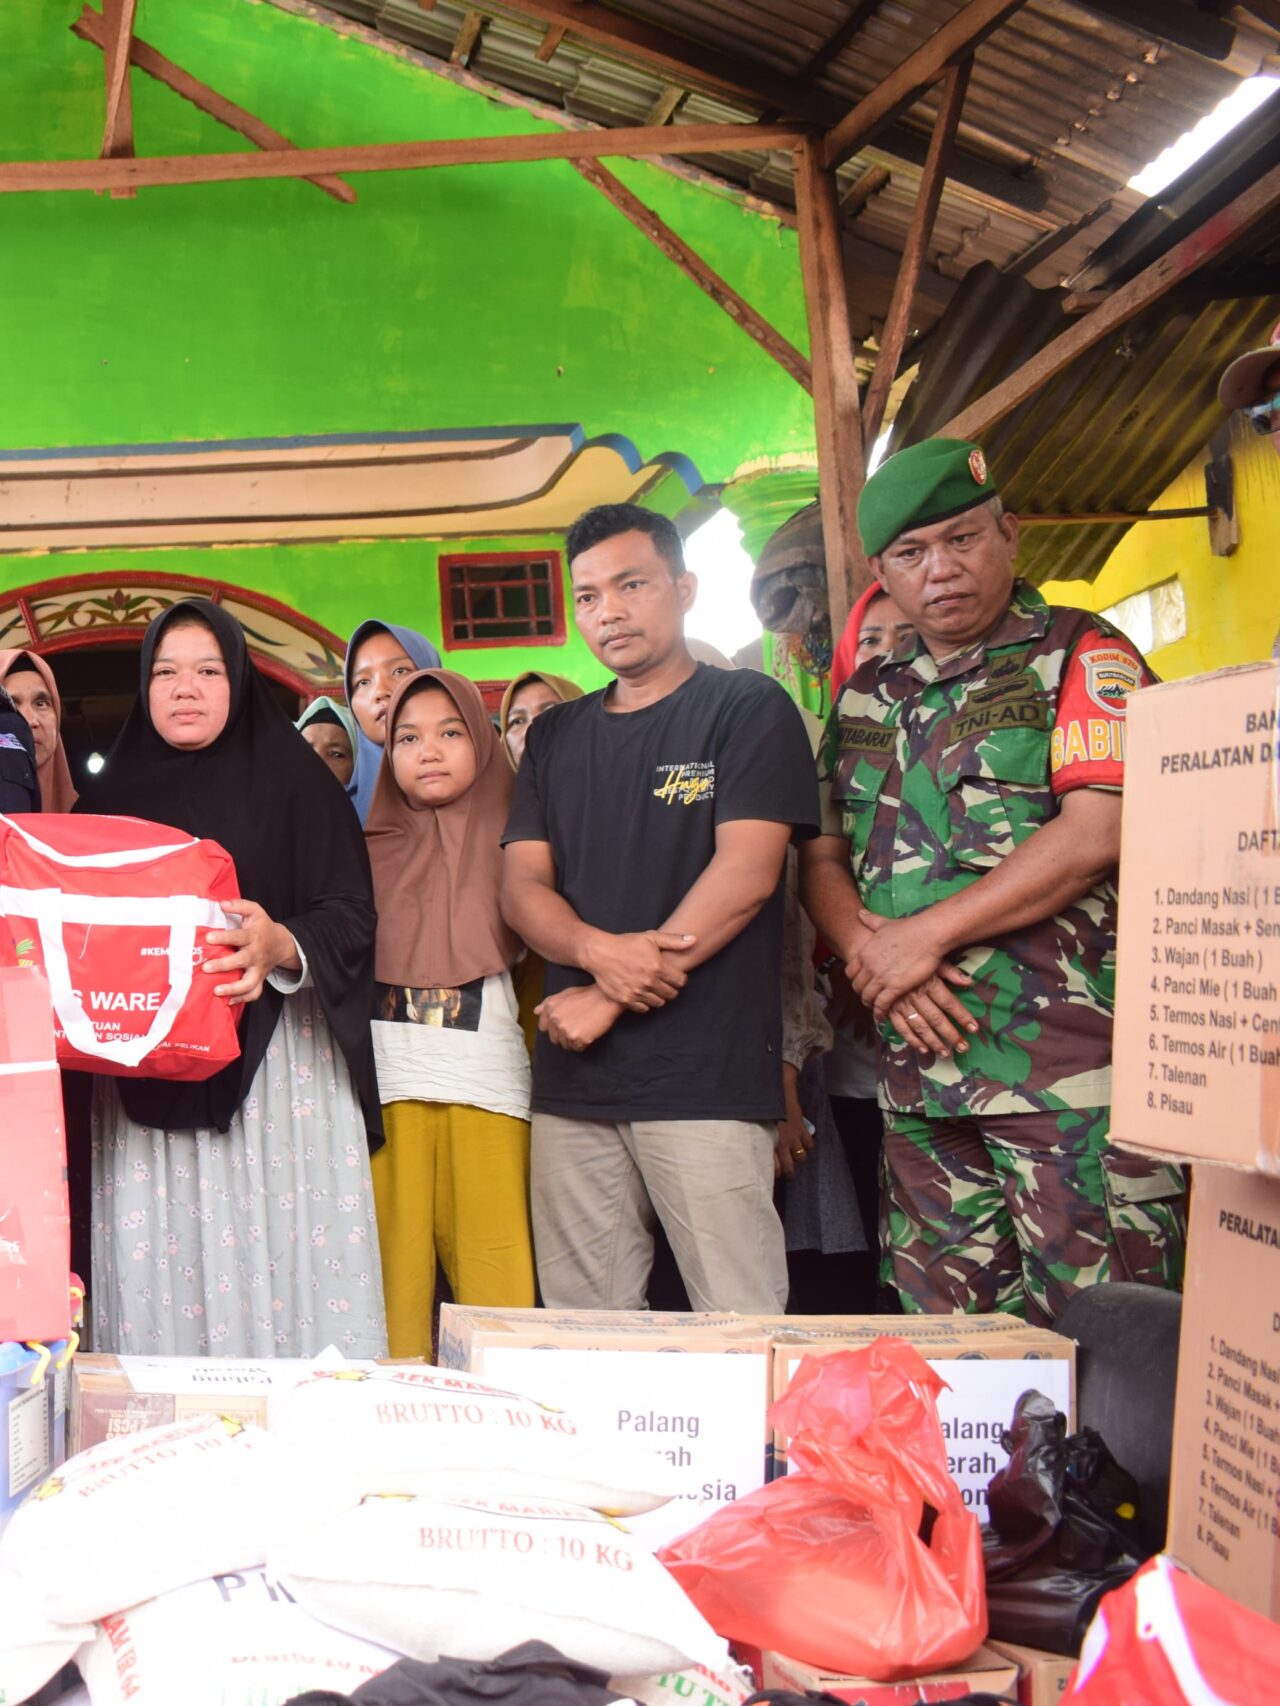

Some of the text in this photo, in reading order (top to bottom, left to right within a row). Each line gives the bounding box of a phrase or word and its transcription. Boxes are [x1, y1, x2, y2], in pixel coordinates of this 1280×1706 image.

[957, 704, 1040, 736] TNI-AD
[1050, 719, 1126, 773] BABI
[1160, 745, 1255, 775] PERALATAN
[1237, 830, 1280, 852] DAFT
[1154, 888, 1163, 905] 1.
[1166, 888, 1219, 909] Dandang
[1222, 886, 1250, 905] Nasi
[1152, 918, 1162, 934] 2.
[1166, 918, 1198, 935] Panci
[1201, 918, 1240, 936] Masak
[1151, 946, 1161, 964] 3.
[1164, 946, 1199, 969] Wajan
[1221, 949, 1254, 968] Buah
[90, 991, 161, 1011] WARE
[1150, 975, 1160, 993] 4.
[1163, 976, 1196, 995] Panci
[1199, 978, 1220, 996] Mie
[1243, 981, 1277, 1001] Buah
[1149, 1004, 1159, 1022] 5.
[1163, 1005, 1206, 1026] Termos
[1209, 1009, 1237, 1030] Nasi
[1148, 1033, 1158, 1051] 6.
[1162, 1034, 1205, 1057] Termos
[1208, 1040, 1227, 1060] Air
[1148, 1062, 1207, 1088] 7. Talenan
[1147, 1090, 1193, 1115] 8. Pisau
[1219, 1208, 1280, 1251] PERALATA
[1219, 1339, 1258, 1378] Dandang
[1217, 1366, 1241, 1394] Panci
[1243, 1380, 1272, 1411] Masak
[374, 1402, 484, 1425] BRUTTO
[507, 1408, 532, 1428] 10
[541, 1413, 577, 1436] KG
[1215, 1393, 1241, 1423] Wajan
[108, 1418, 138, 1433] PCS!
[618, 1410, 700, 1438] Palang
[940, 1417, 1004, 1445] alang
[1213, 1421, 1238, 1449] Panci
[1239, 1437, 1255, 1460] Mie
[946, 1451, 997, 1474] erah
[1212, 1448, 1243, 1483] Termos
[1244, 1470, 1266, 1498] Nasi
[1210, 1474, 1241, 1511] Termos
[1242, 1499, 1256, 1520] Air
[1208, 1501, 1242, 1542] Talenan
[419, 1527, 534, 1553] BRUTTO
[558, 1535, 586, 1561] 10
[595, 1543, 634, 1572] KG
[1205, 1529, 1230, 1562] Pisau
